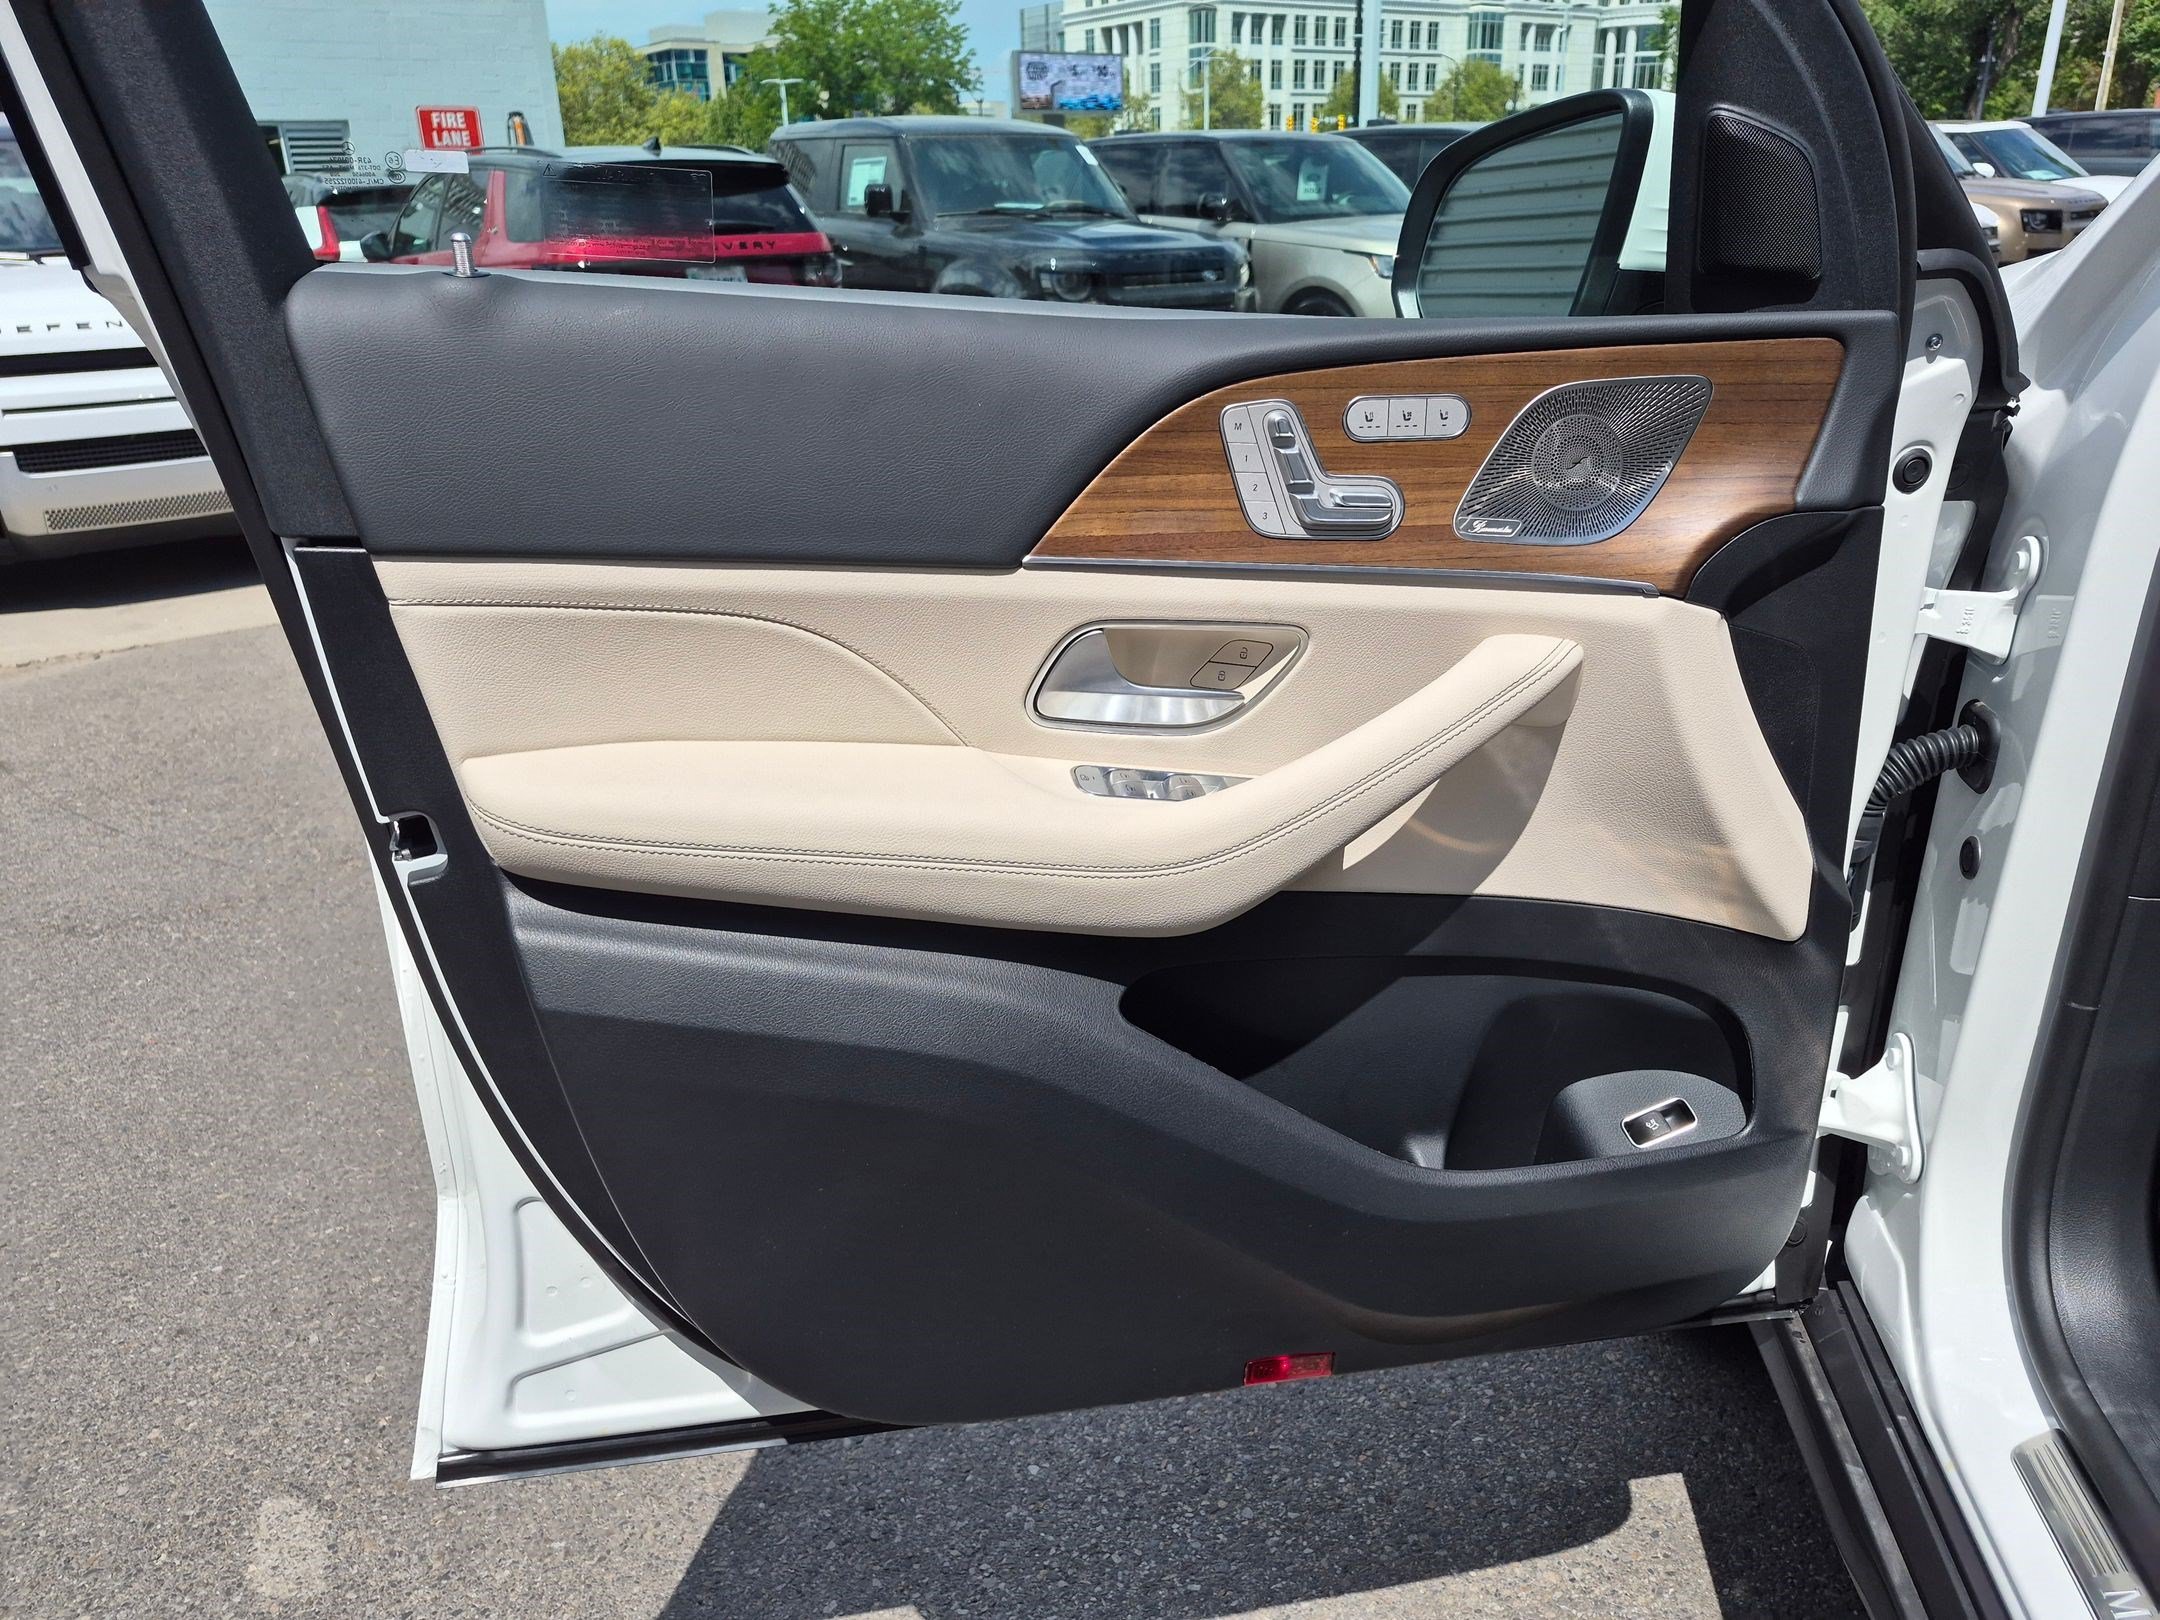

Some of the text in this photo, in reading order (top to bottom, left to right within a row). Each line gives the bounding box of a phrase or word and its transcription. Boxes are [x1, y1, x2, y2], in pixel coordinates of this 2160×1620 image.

[430, 111, 467, 129] FIRE
[432, 129, 472, 147] LANE
[715, 240, 776, 251] VERY
[0, 320, 123, 334] EFEN
[1233, 422, 1242, 431] M
[1252, 484, 1258, 492] 2
[1262, 512, 1268, 520] 3
